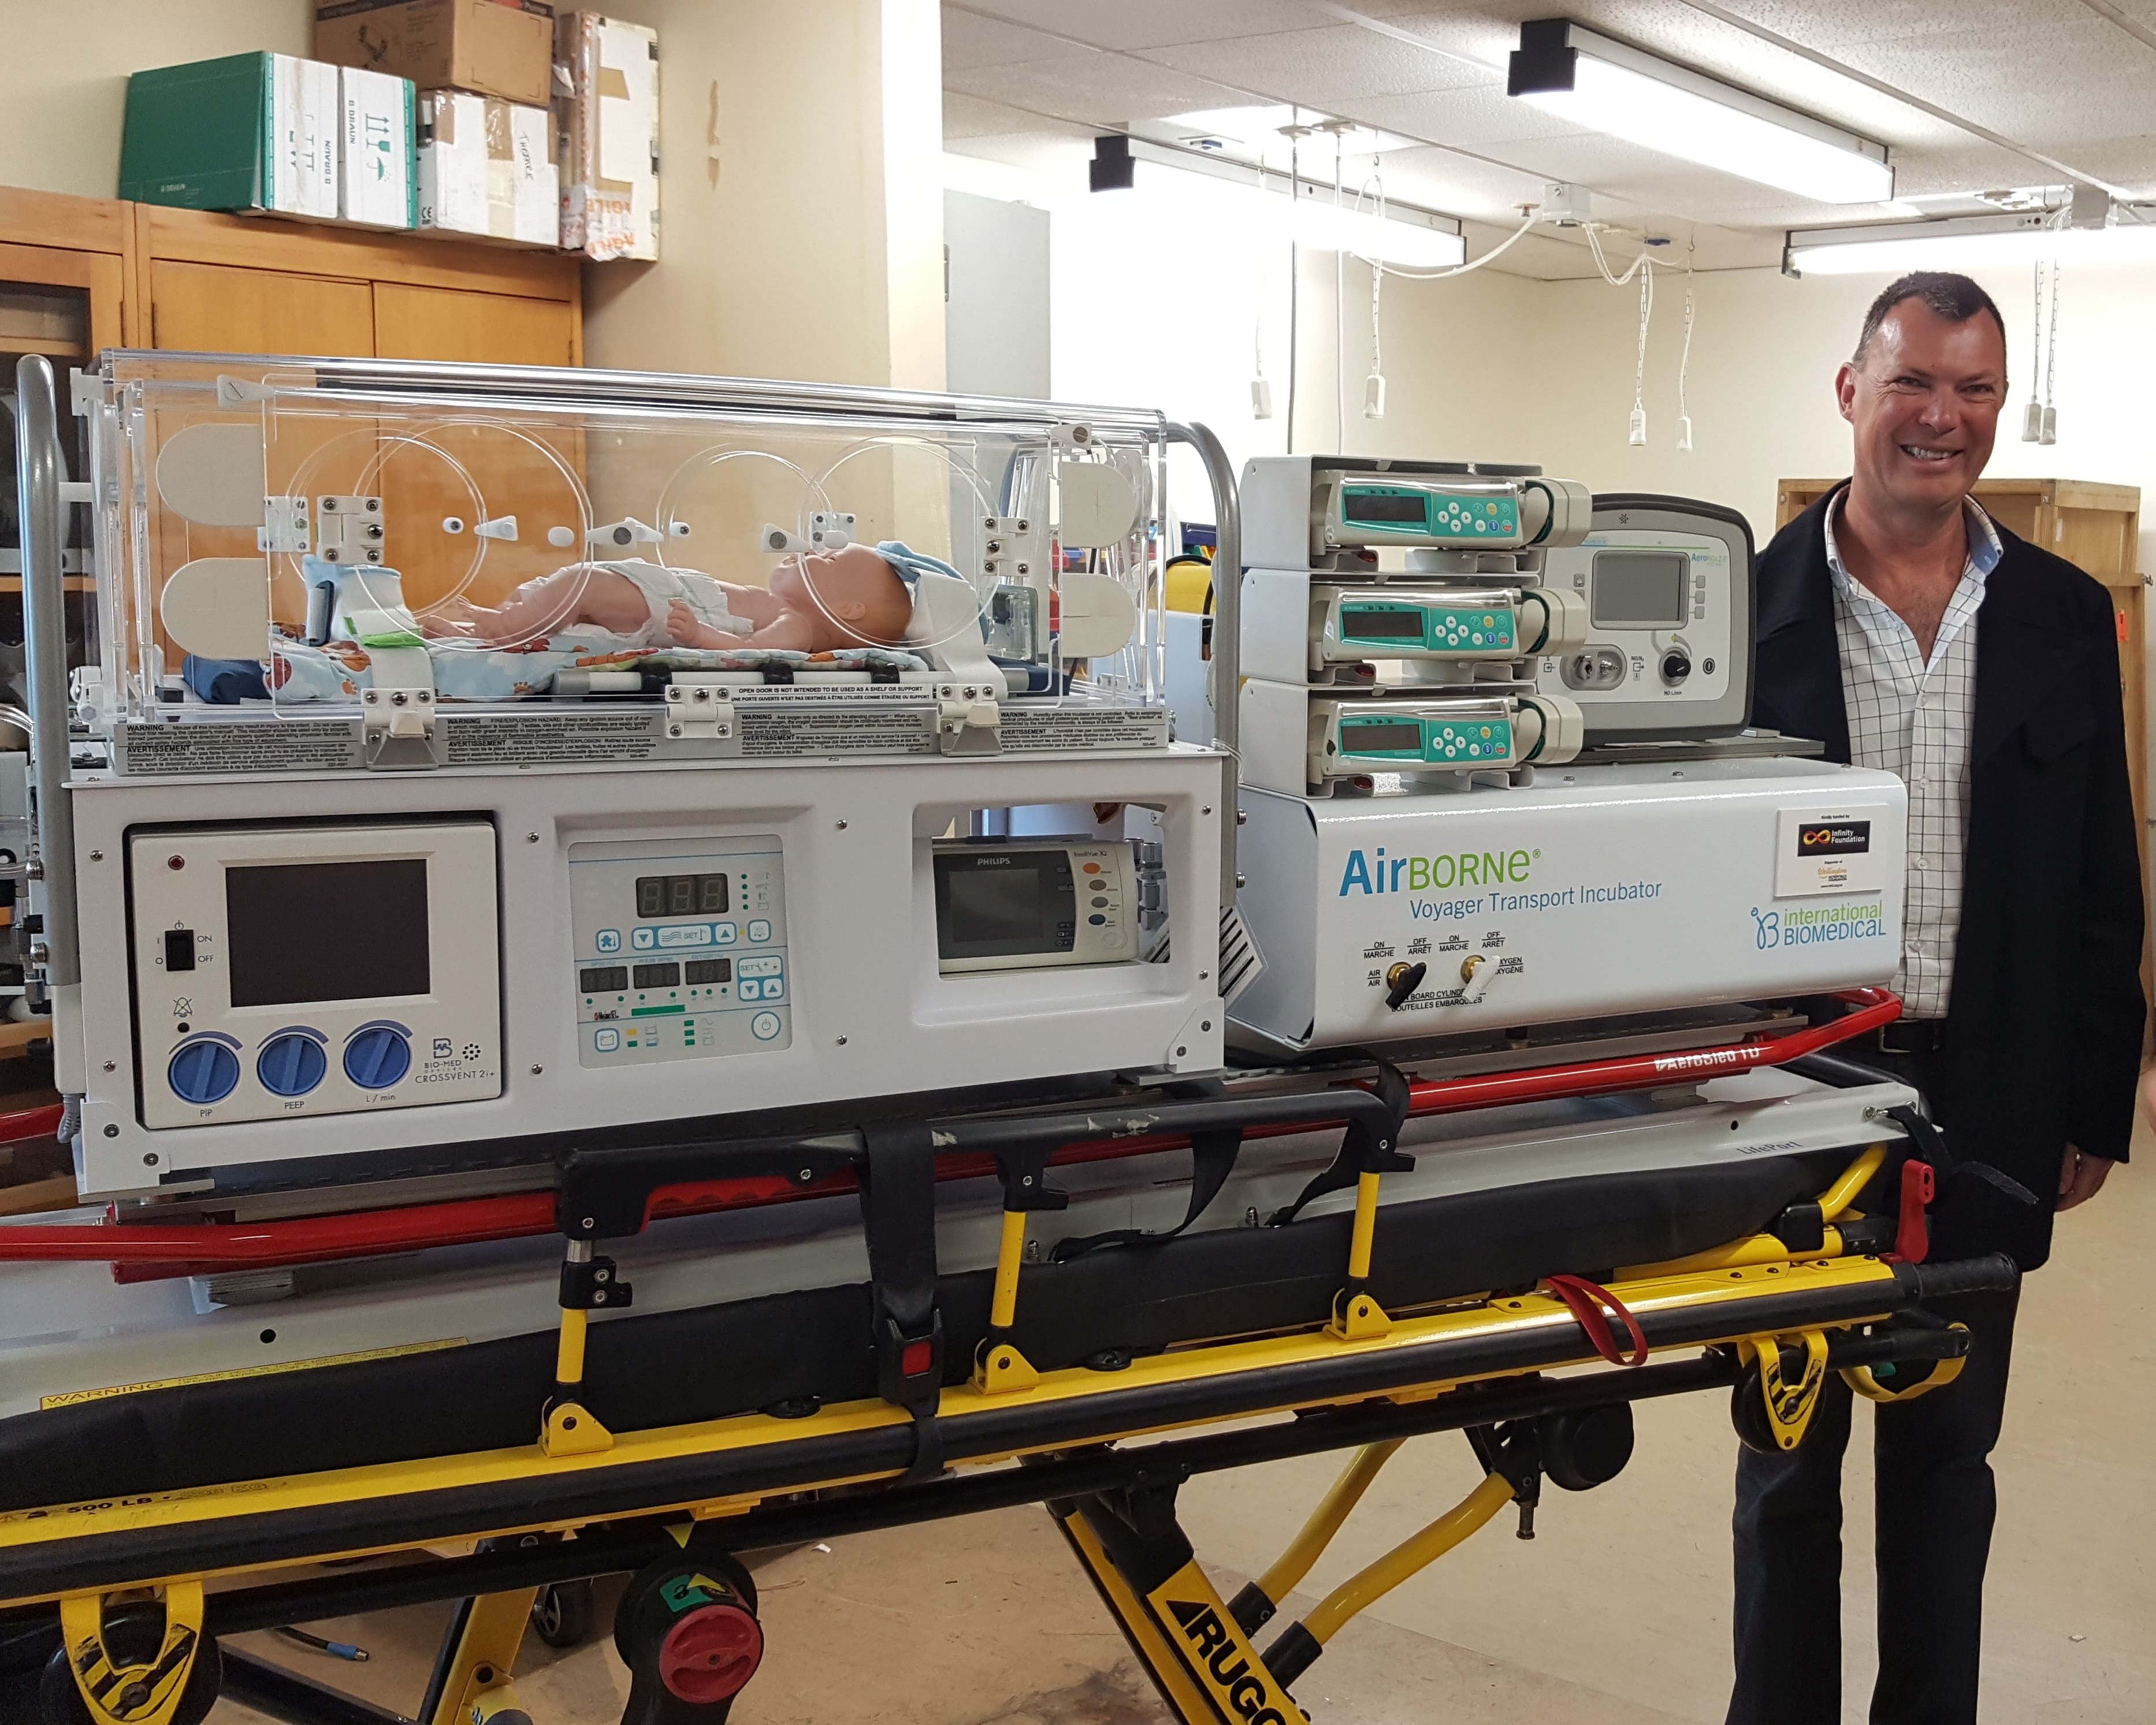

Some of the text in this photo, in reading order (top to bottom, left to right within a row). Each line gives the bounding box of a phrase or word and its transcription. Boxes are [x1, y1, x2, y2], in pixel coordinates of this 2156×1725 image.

[977, 857, 1010, 865] PHILIPS
[1410, 880, 1662, 922] Voyager Transport Incubator
[1785, 900, 1882, 927] international
[1439, 943, 1469, 952] MARCHE
[1482, 940, 1505, 948] ARRÊT
[1364, 950, 1395, 958] MARCHE
[1408, 946, 1432, 954] ARRÊT
[1495, 965, 1524, 975] XYGÈNE
[1411, 992, 1435, 1000] BOARD
[1392, 997, 1482, 1012] OUTEILLES EMBARQUES
[425, 1060, 462, 1069] BIO-MED
[415, 1070, 476, 1084] CROSSVENT
[284, 1101, 304, 1109] PEEP
[200, 1109, 213, 1118] PIP
[1736, 1142, 1804, 1154] LifePort
[47, 1382, 163, 1403] WARNING
[67, 1497, 153, 1514] 500 LB
